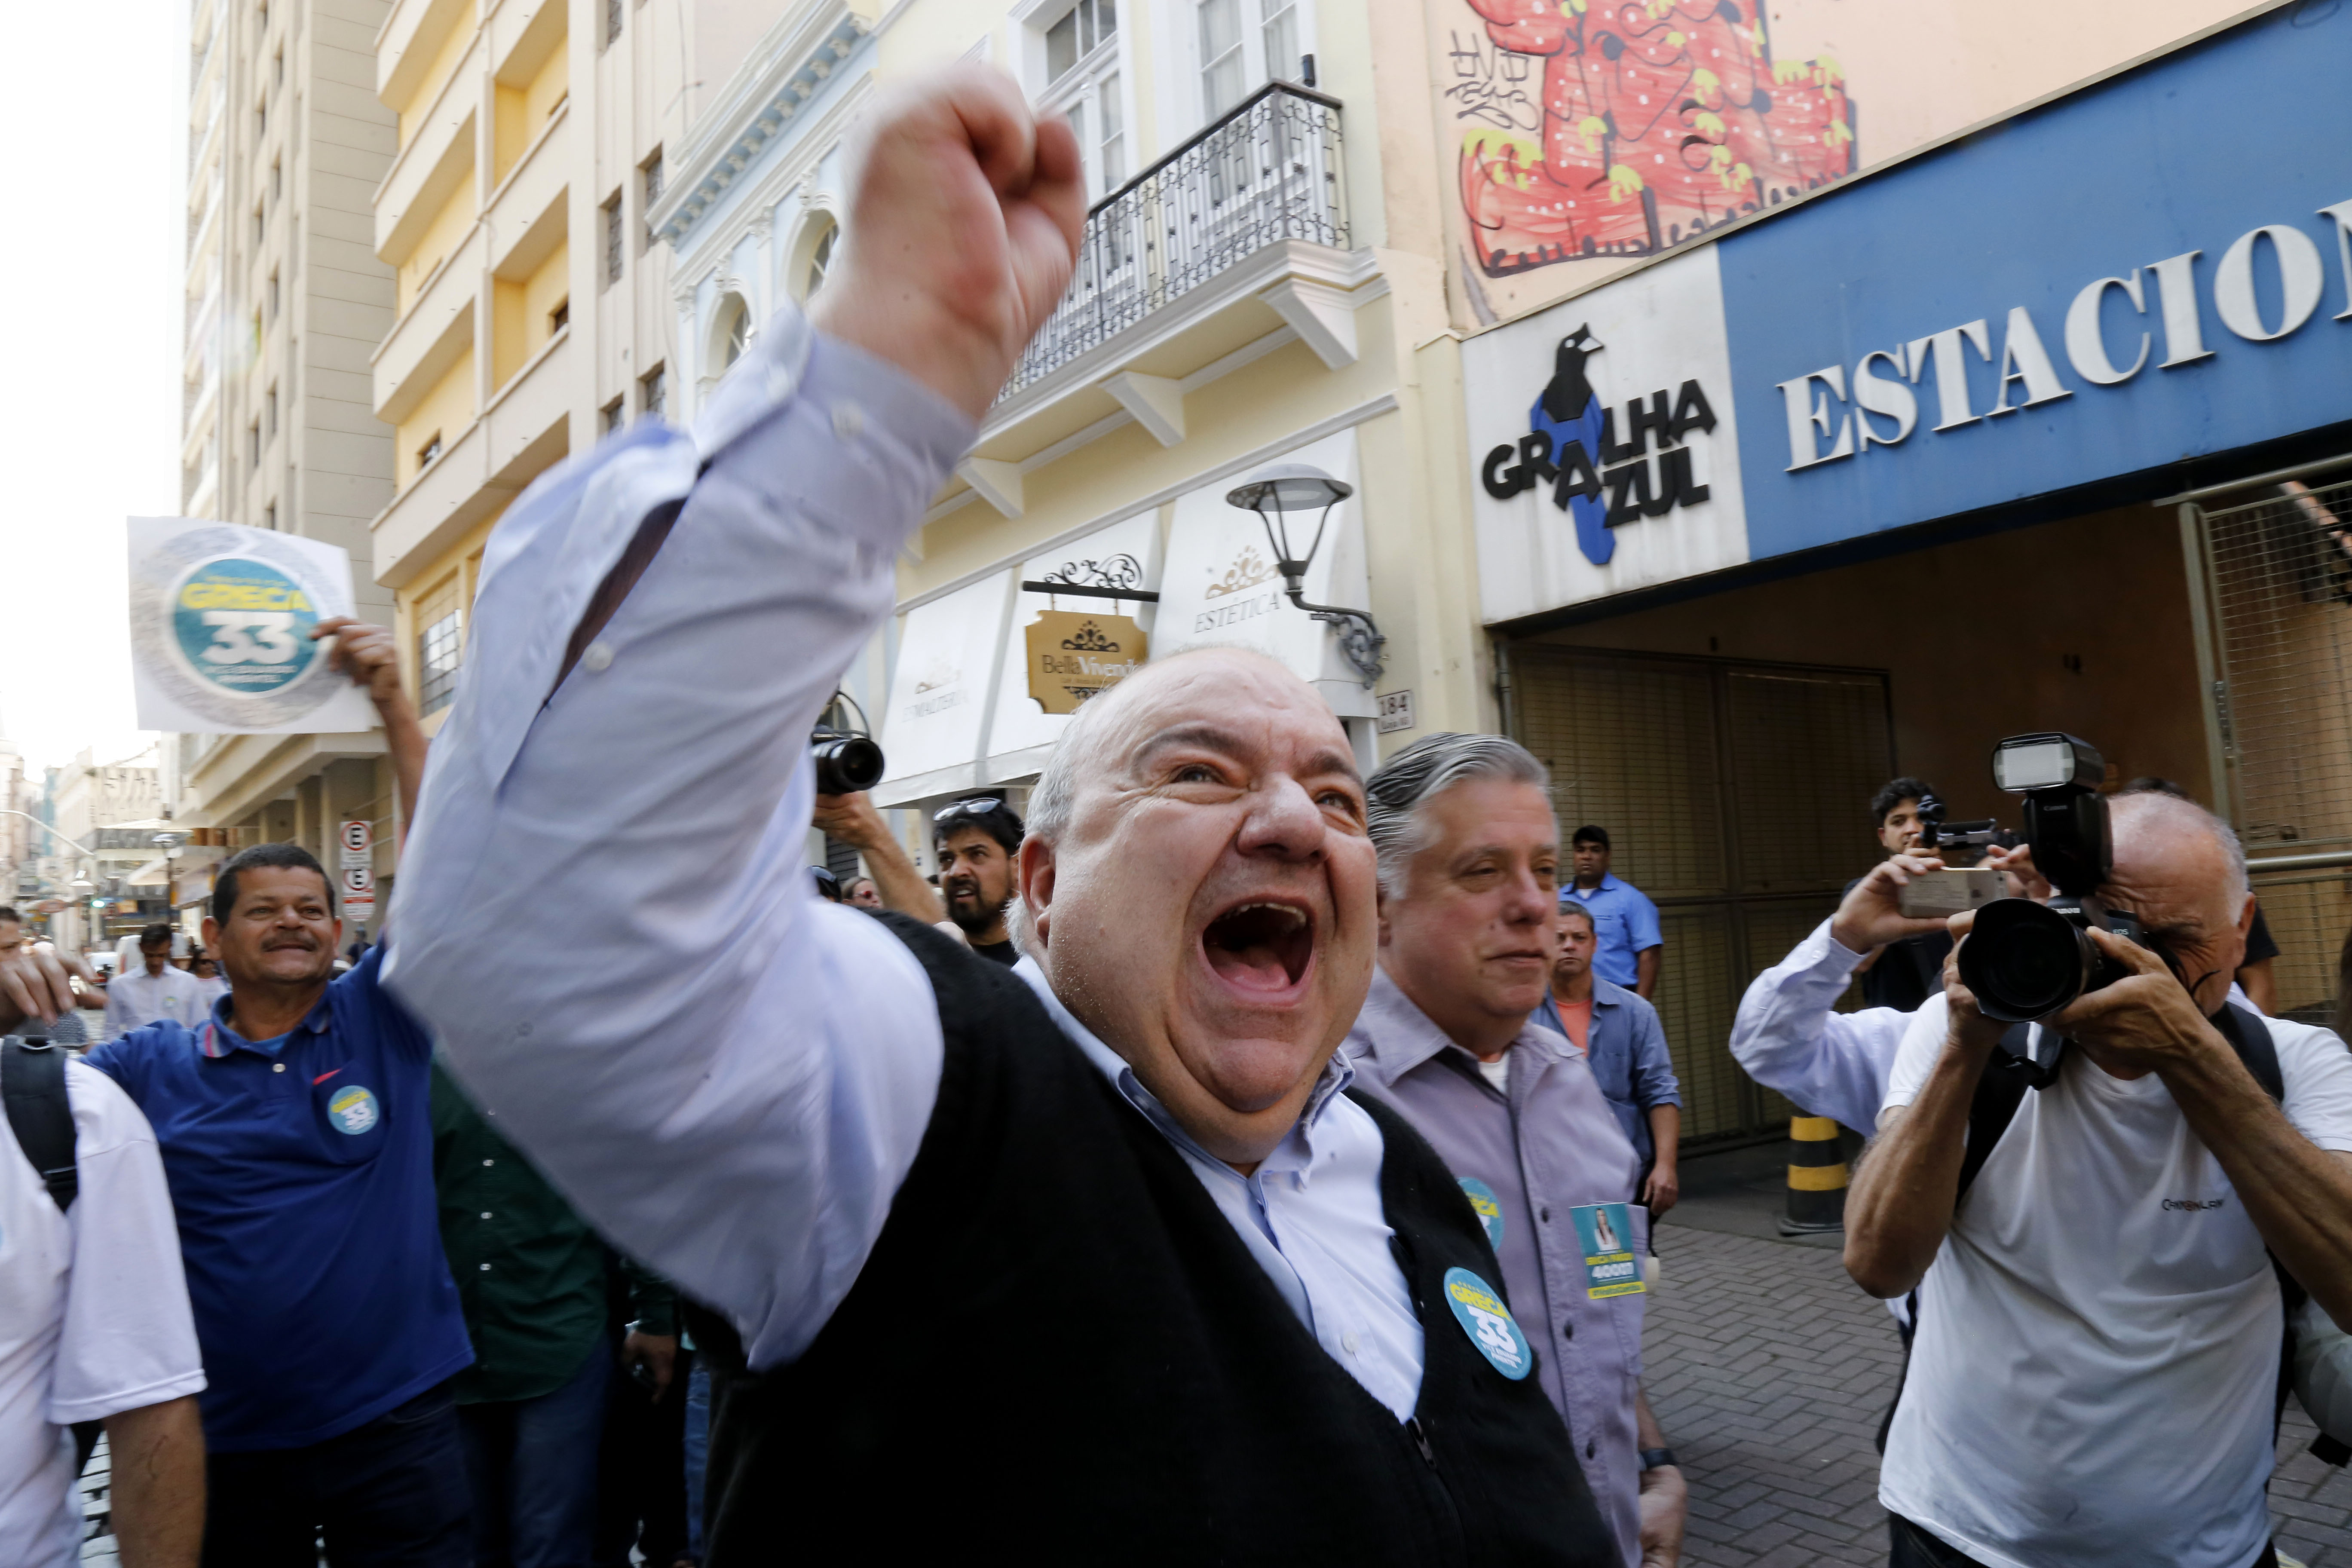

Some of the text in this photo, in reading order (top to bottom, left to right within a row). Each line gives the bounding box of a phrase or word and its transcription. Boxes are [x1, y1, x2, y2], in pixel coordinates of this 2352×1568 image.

[1482, 379, 1717, 511] GRALHA
[1194, 591, 1280, 634] ESTÉTICA
[200, 610, 299, 665] 33
[1378, 694, 1408, 716] 184
[1449, 1283, 1512, 1322] GRECA
[1466, 1304, 1518, 1354] 33
